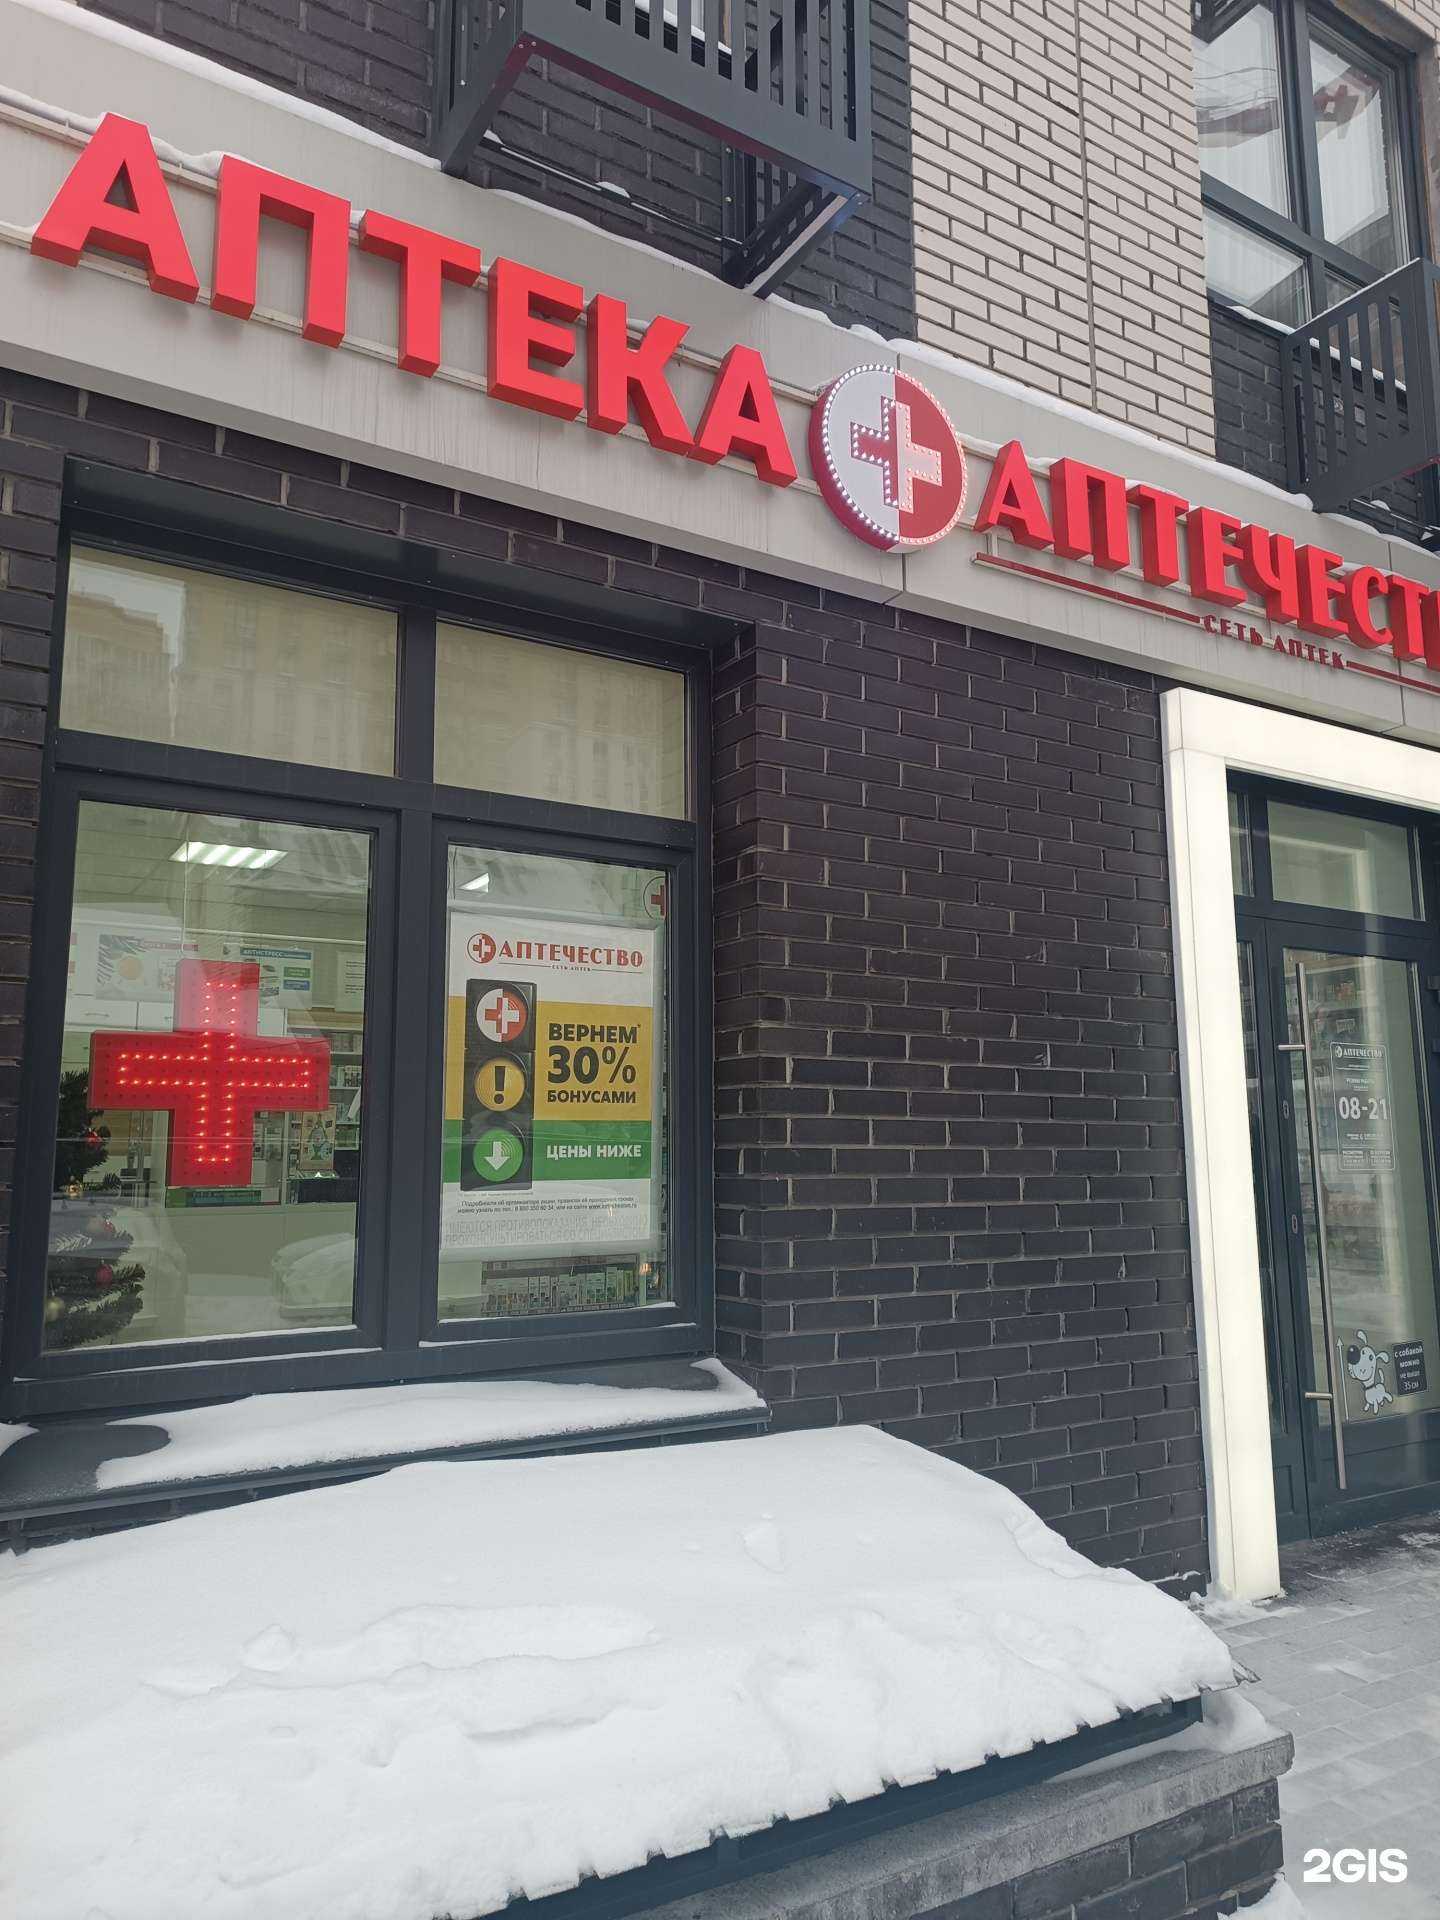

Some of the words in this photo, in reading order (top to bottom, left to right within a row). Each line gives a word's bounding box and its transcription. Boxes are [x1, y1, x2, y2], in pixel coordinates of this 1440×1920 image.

[31, 111, 797, 488] АПТЕКА
[974, 440, 1440, 672] АПТЕЧЕСТ
[1204, 614, 1263, 646] СЕТЬ
[1273, 635, 1345, 670] АПТЕК
[499, 941, 643, 967] АПТЕЧЕСТВО
[547, 1045, 637, 1084] 30%
[547, 1090, 636, 1103] БОНУСАМИ
[1339, 1096, 1388, 1120] 08-21
[546, 1144, 592, 1160] ЦЕНЫ
[596, 1144, 642, 1158] НИЖЕ
[1399, 1345, 1423, 1357] собакой
[1400, 1359, 1420, 1368] можно
[1403, 1381, 1411, 1391] 35
